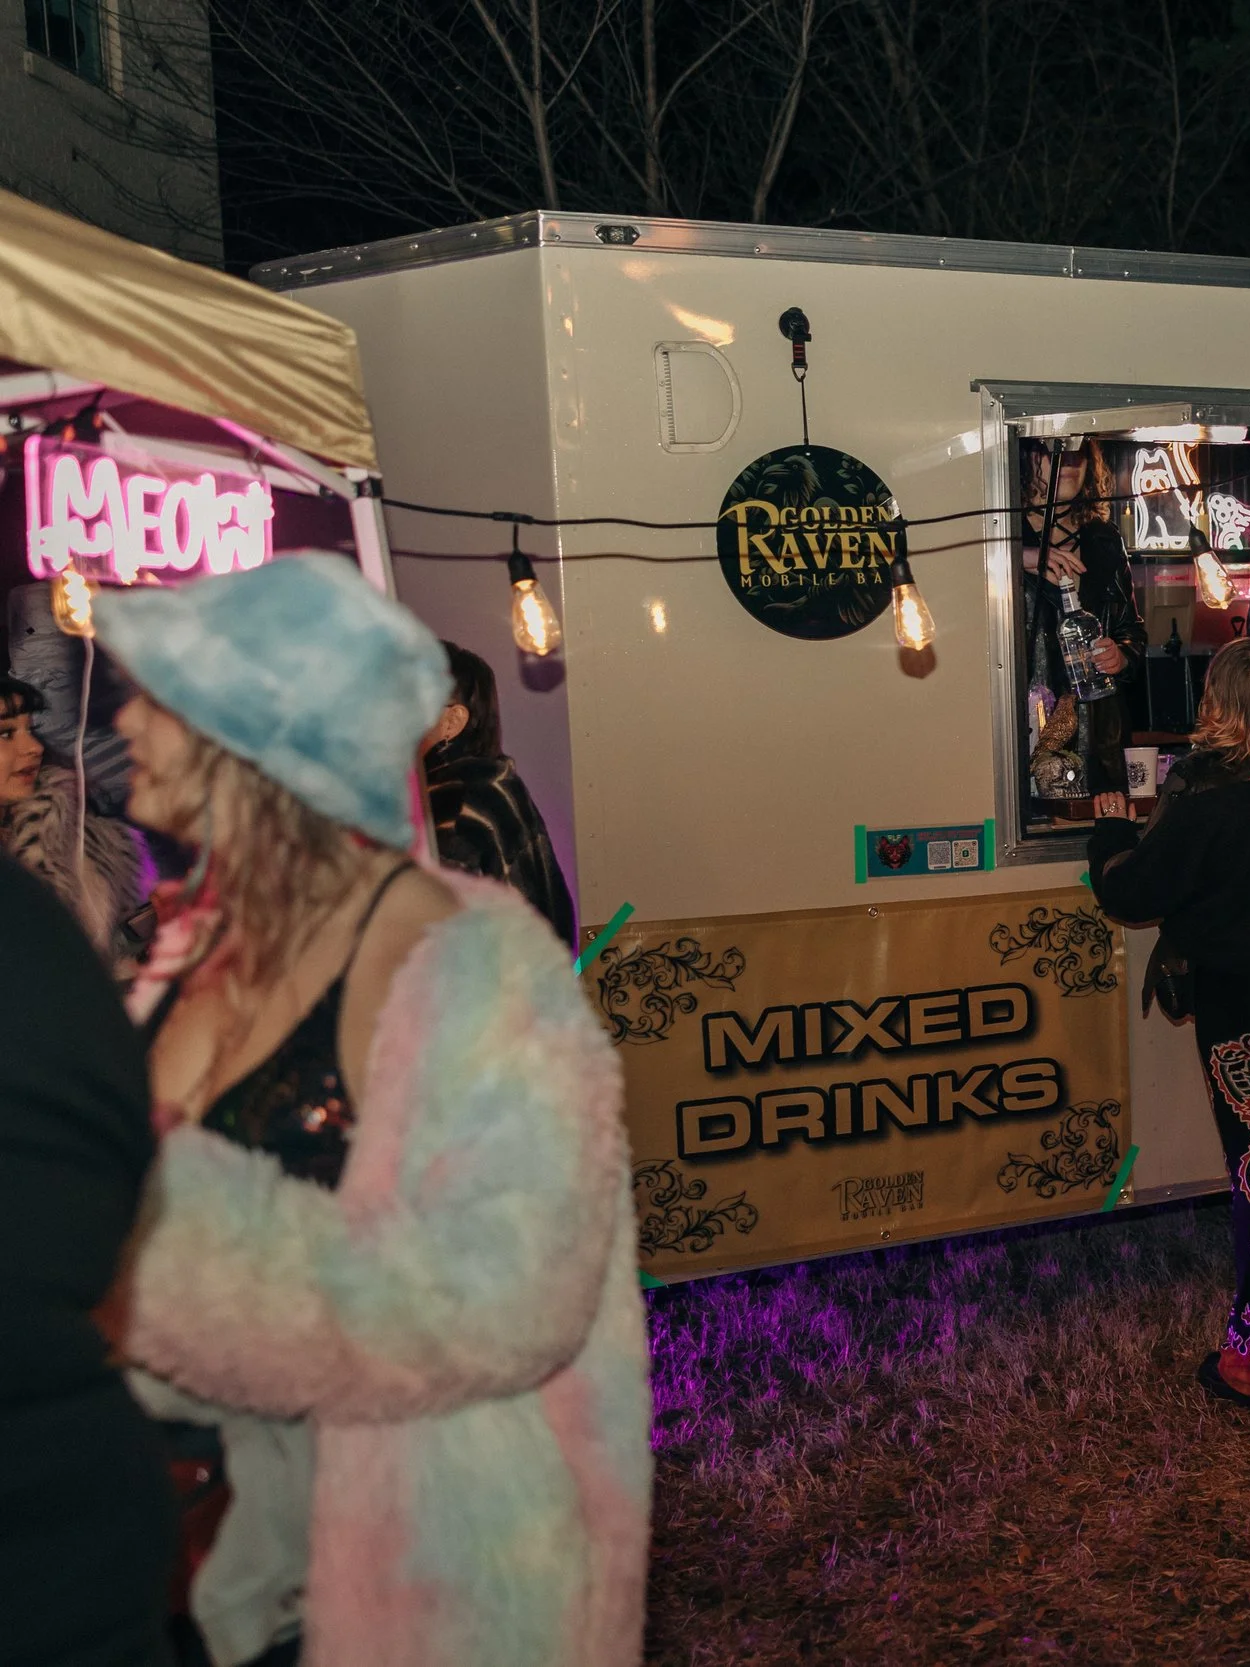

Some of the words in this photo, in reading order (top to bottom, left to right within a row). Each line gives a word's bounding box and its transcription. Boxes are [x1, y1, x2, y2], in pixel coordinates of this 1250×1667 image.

[50, 455, 270, 583] MEOW
[718, 500, 898, 575] RAVEN
[780, 506, 894, 530] GOLDEN
[741, 572, 836, 587] MOBILE
[857, 571, 883, 585] BA
[702, 982, 1034, 1072] MIXED
[676, 1058, 1062, 1162] DRINKS
[832, 1177, 923, 1214] RAVEN
[863, 1170, 924, 1190] GOLDEN
